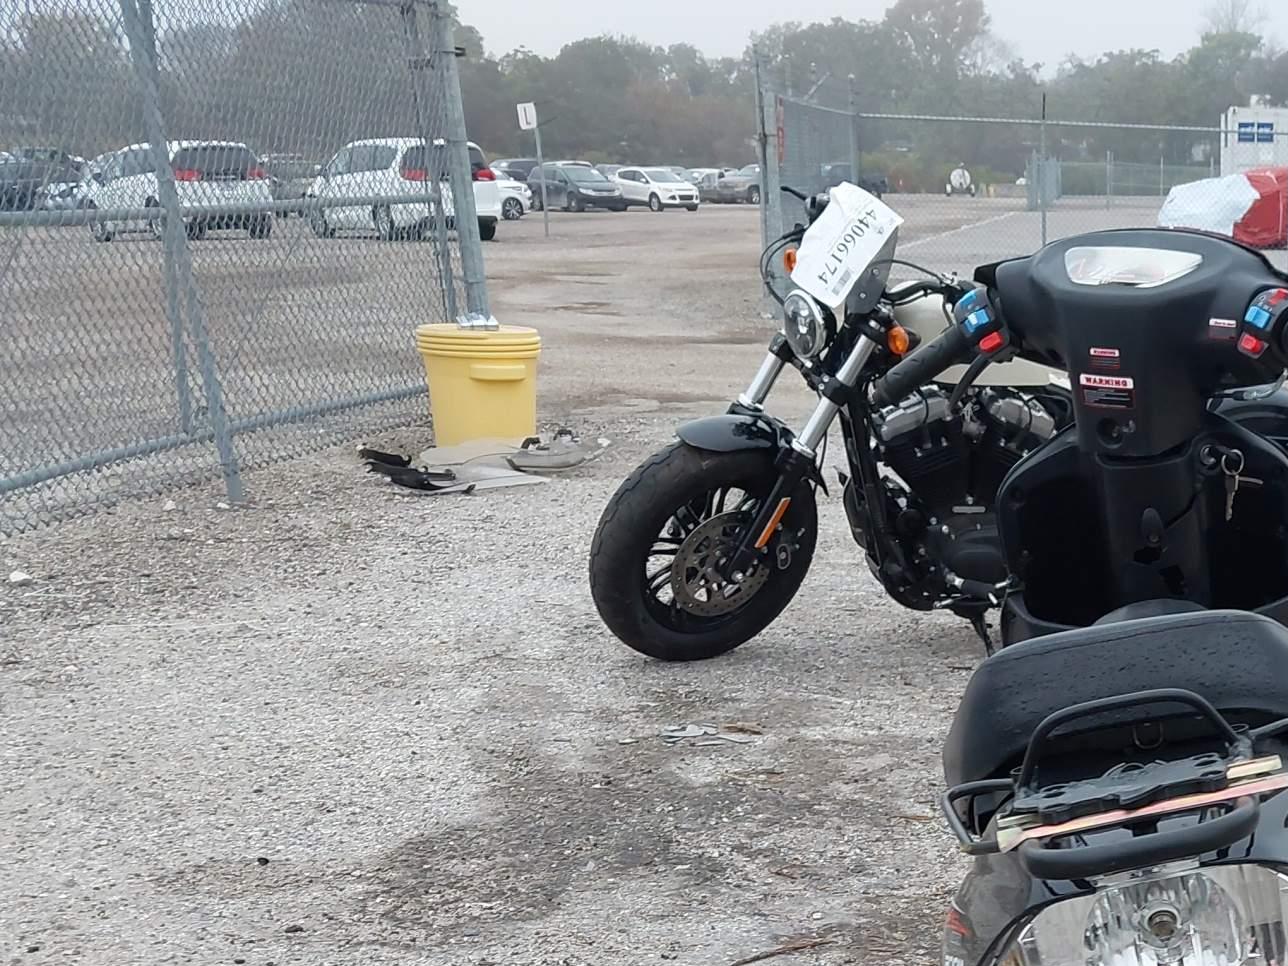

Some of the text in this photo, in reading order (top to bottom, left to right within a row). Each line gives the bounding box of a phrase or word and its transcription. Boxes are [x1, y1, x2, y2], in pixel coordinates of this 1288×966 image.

[523, 106, 531, 125] L
[817, 209, 877, 285] 44066174
[1084, 376, 1128, 387] WARNING
